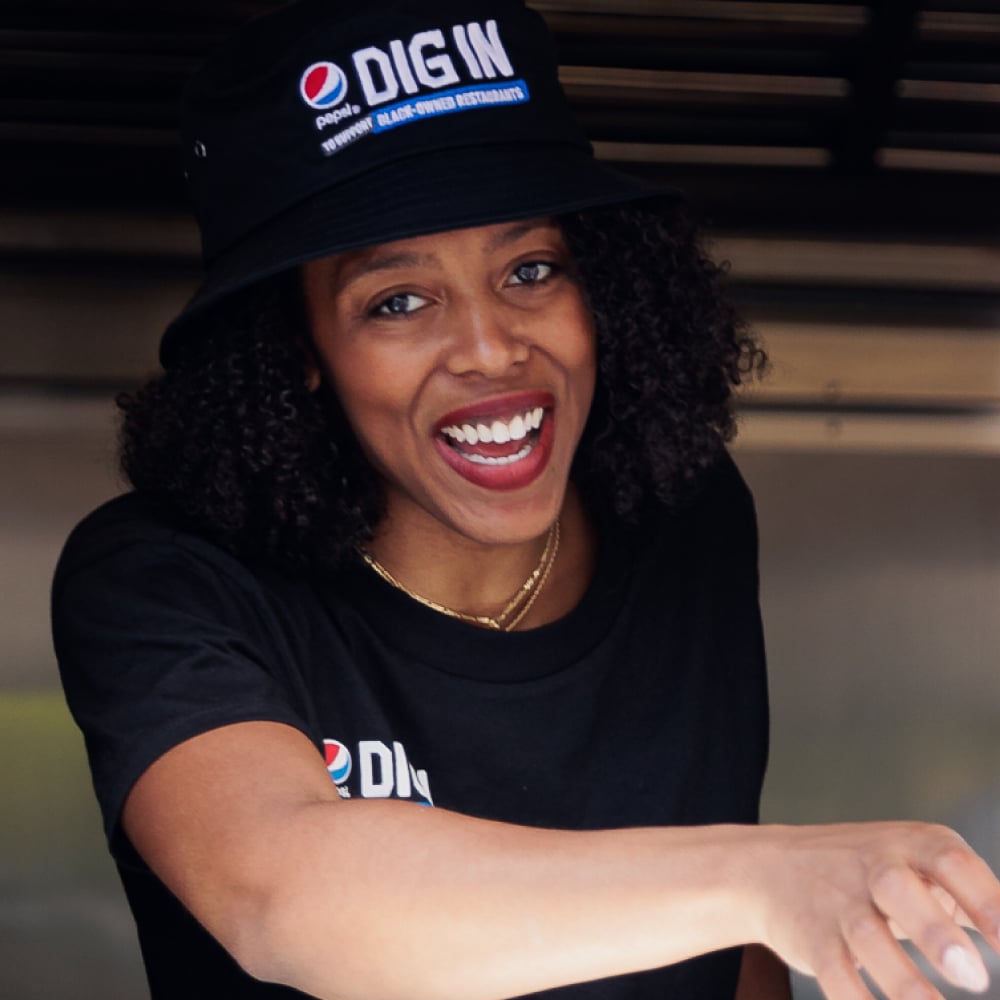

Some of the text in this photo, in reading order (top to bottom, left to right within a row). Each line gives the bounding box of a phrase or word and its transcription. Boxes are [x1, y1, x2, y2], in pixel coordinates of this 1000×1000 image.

[352, 19, 515, 106] DIG IN
[315, 103, 354, 130] pepsi
[376, 96, 457, 127] BLACK-OWNED
[456, 86, 525, 109] RESTAURANTS
